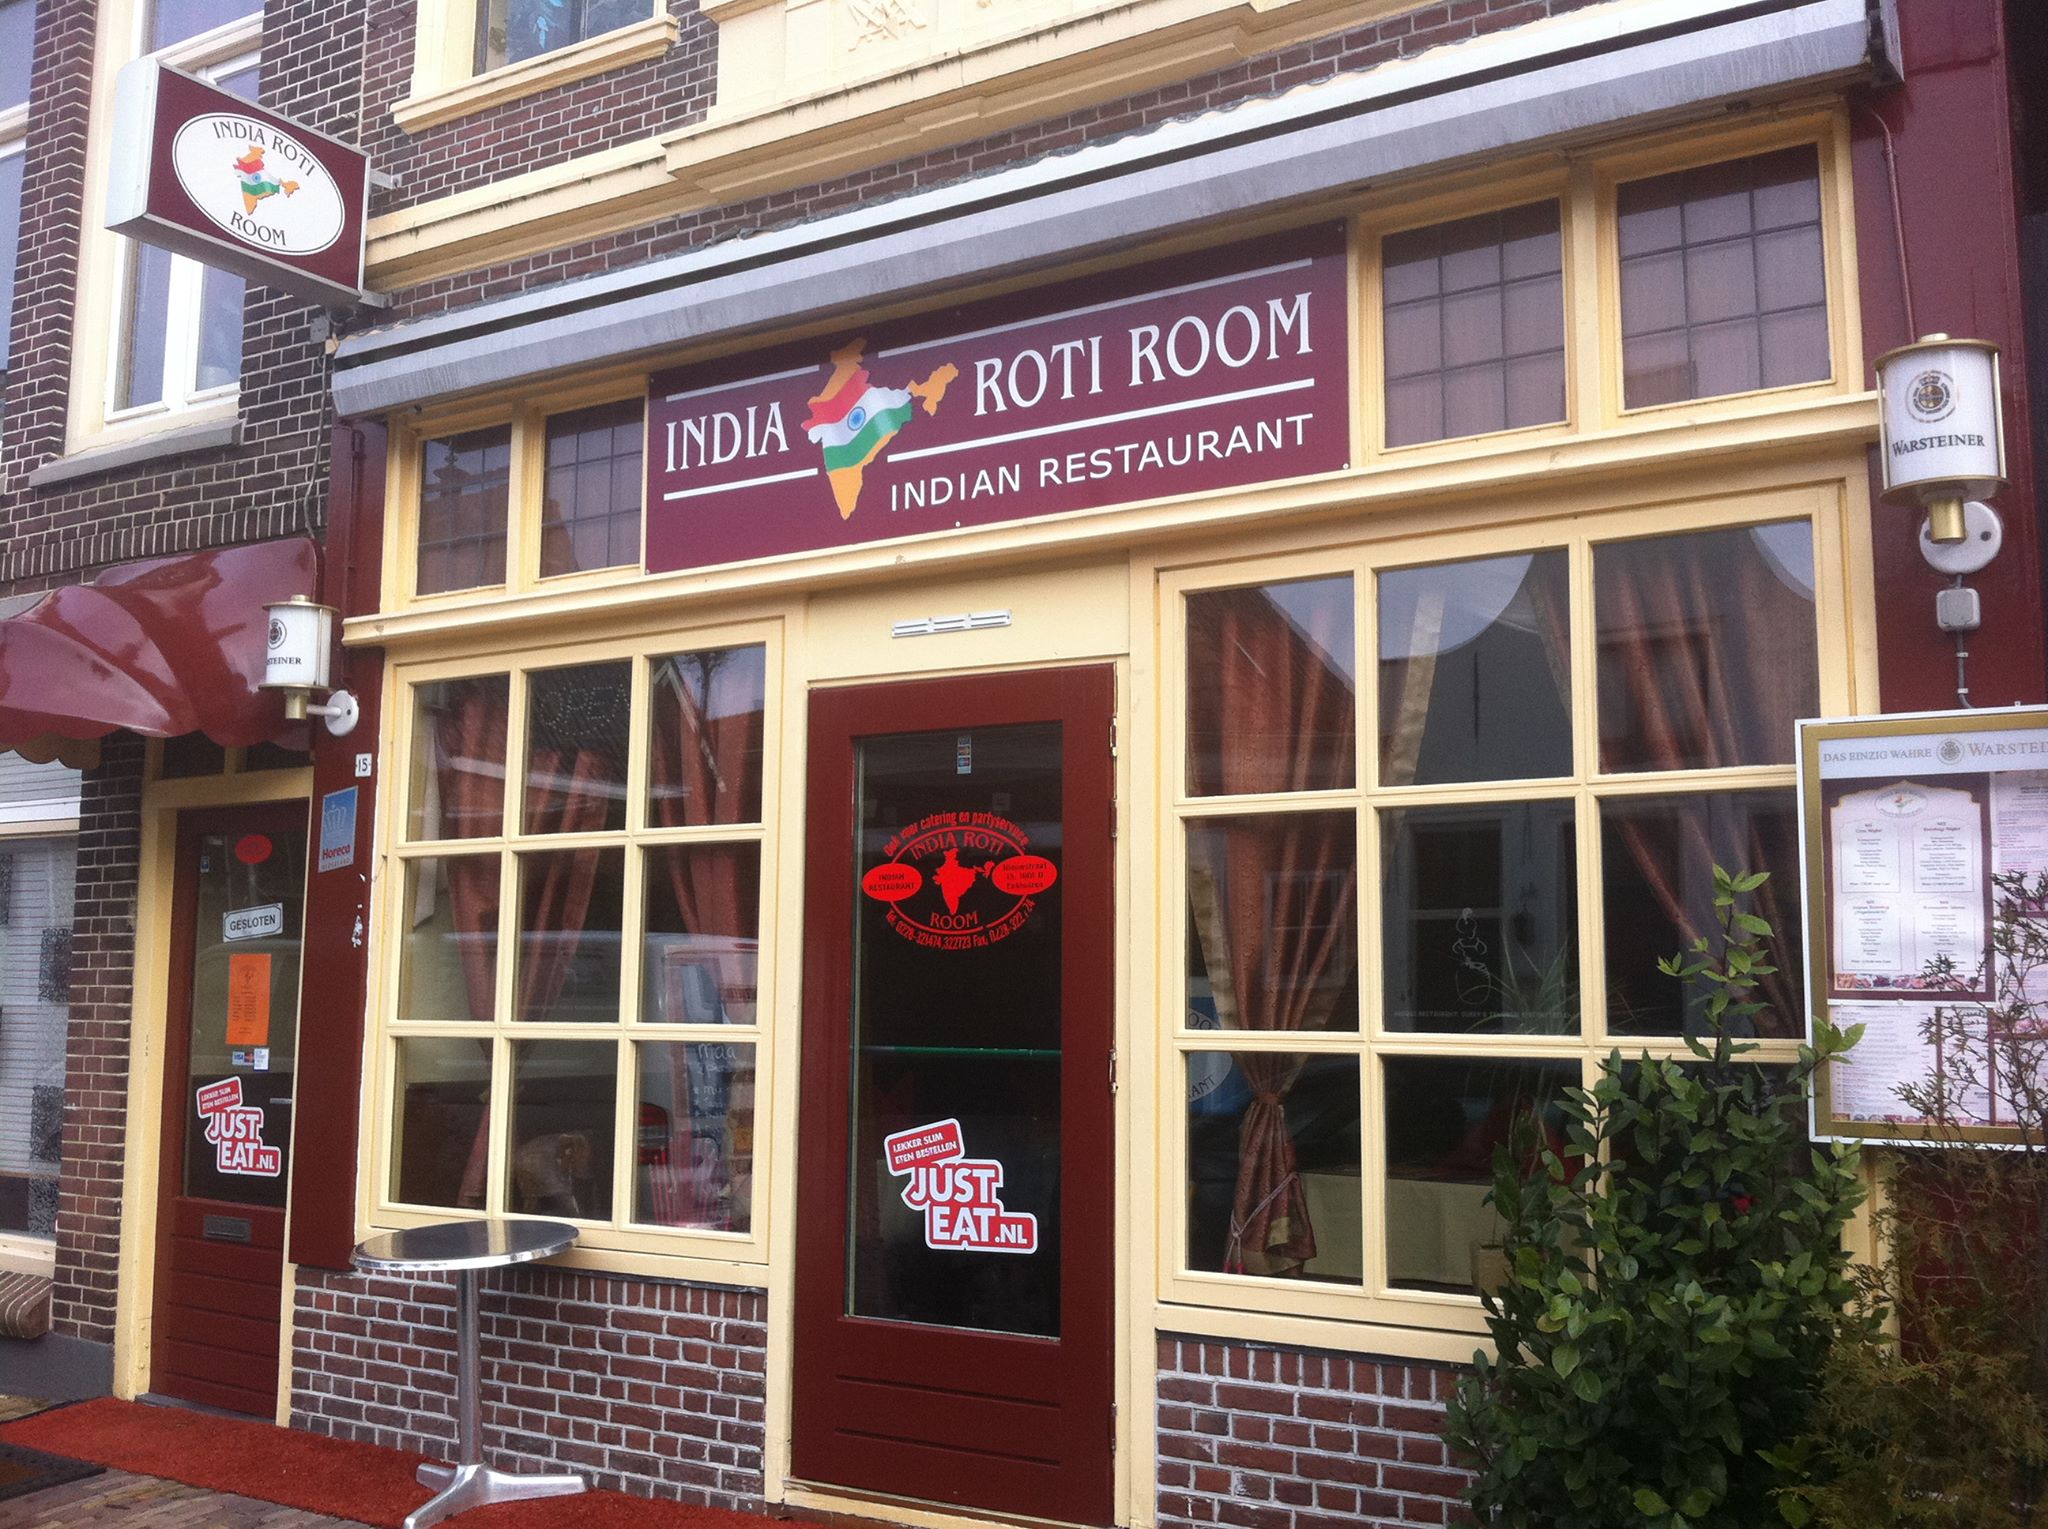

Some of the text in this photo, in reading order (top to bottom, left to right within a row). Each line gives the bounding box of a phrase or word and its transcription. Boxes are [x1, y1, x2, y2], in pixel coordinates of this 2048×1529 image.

[212, 121, 316, 177] INDIA ROTI
[230, 211, 287, 246] ROOM
[664, 291, 1313, 473] INDIA ROTI ROOM
[1892, 434, 1985, 457] WARSTEINER
[890, 412, 1313, 512] INDIAN RESTAURANT
[1823, 740, 2048, 762] DAS EINZIG WAHRE WARSTEI
[358, 758, 368, 772] 15
[920, 811, 957, 831] catering
[322, 844, 351, 860] Horeca
[910, 831, 1005, 860] INDIA ROTI
[229, 914, 276, 931] GESLOTEN
[929, 911, 979, 929] ROOM
[210, 1112, 260, 1139] JUST
[893, 1132, 944, 1153] LEKKER SLIM
[895, 1141, 958, 1165] ETEN BESTELLEN
[910, 1167, 996, 1204] JUST
